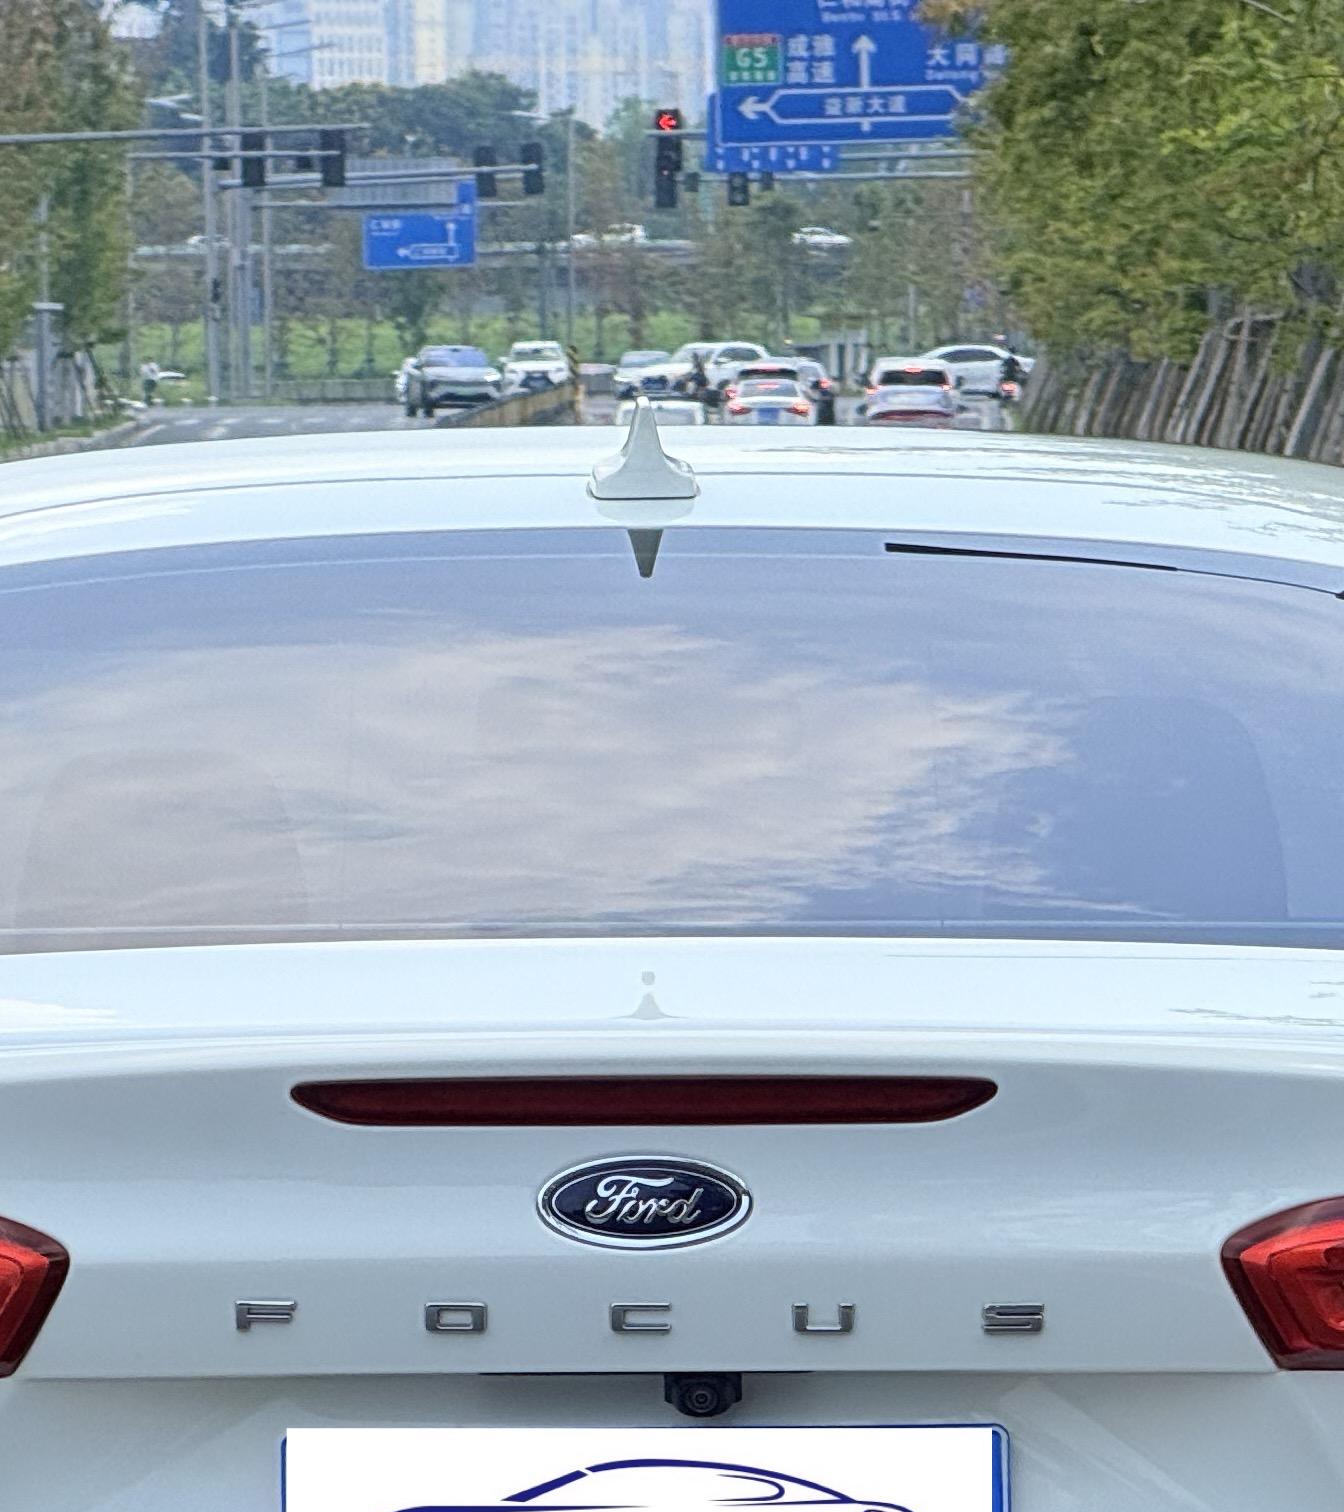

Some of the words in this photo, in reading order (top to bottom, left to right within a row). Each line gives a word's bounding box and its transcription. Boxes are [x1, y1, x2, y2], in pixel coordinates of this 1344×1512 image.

[736, 48, 768, 68] G5
[585, 1174, 704, 1226] Ford
[234, 1299, 1046, 1334] FOCUS
